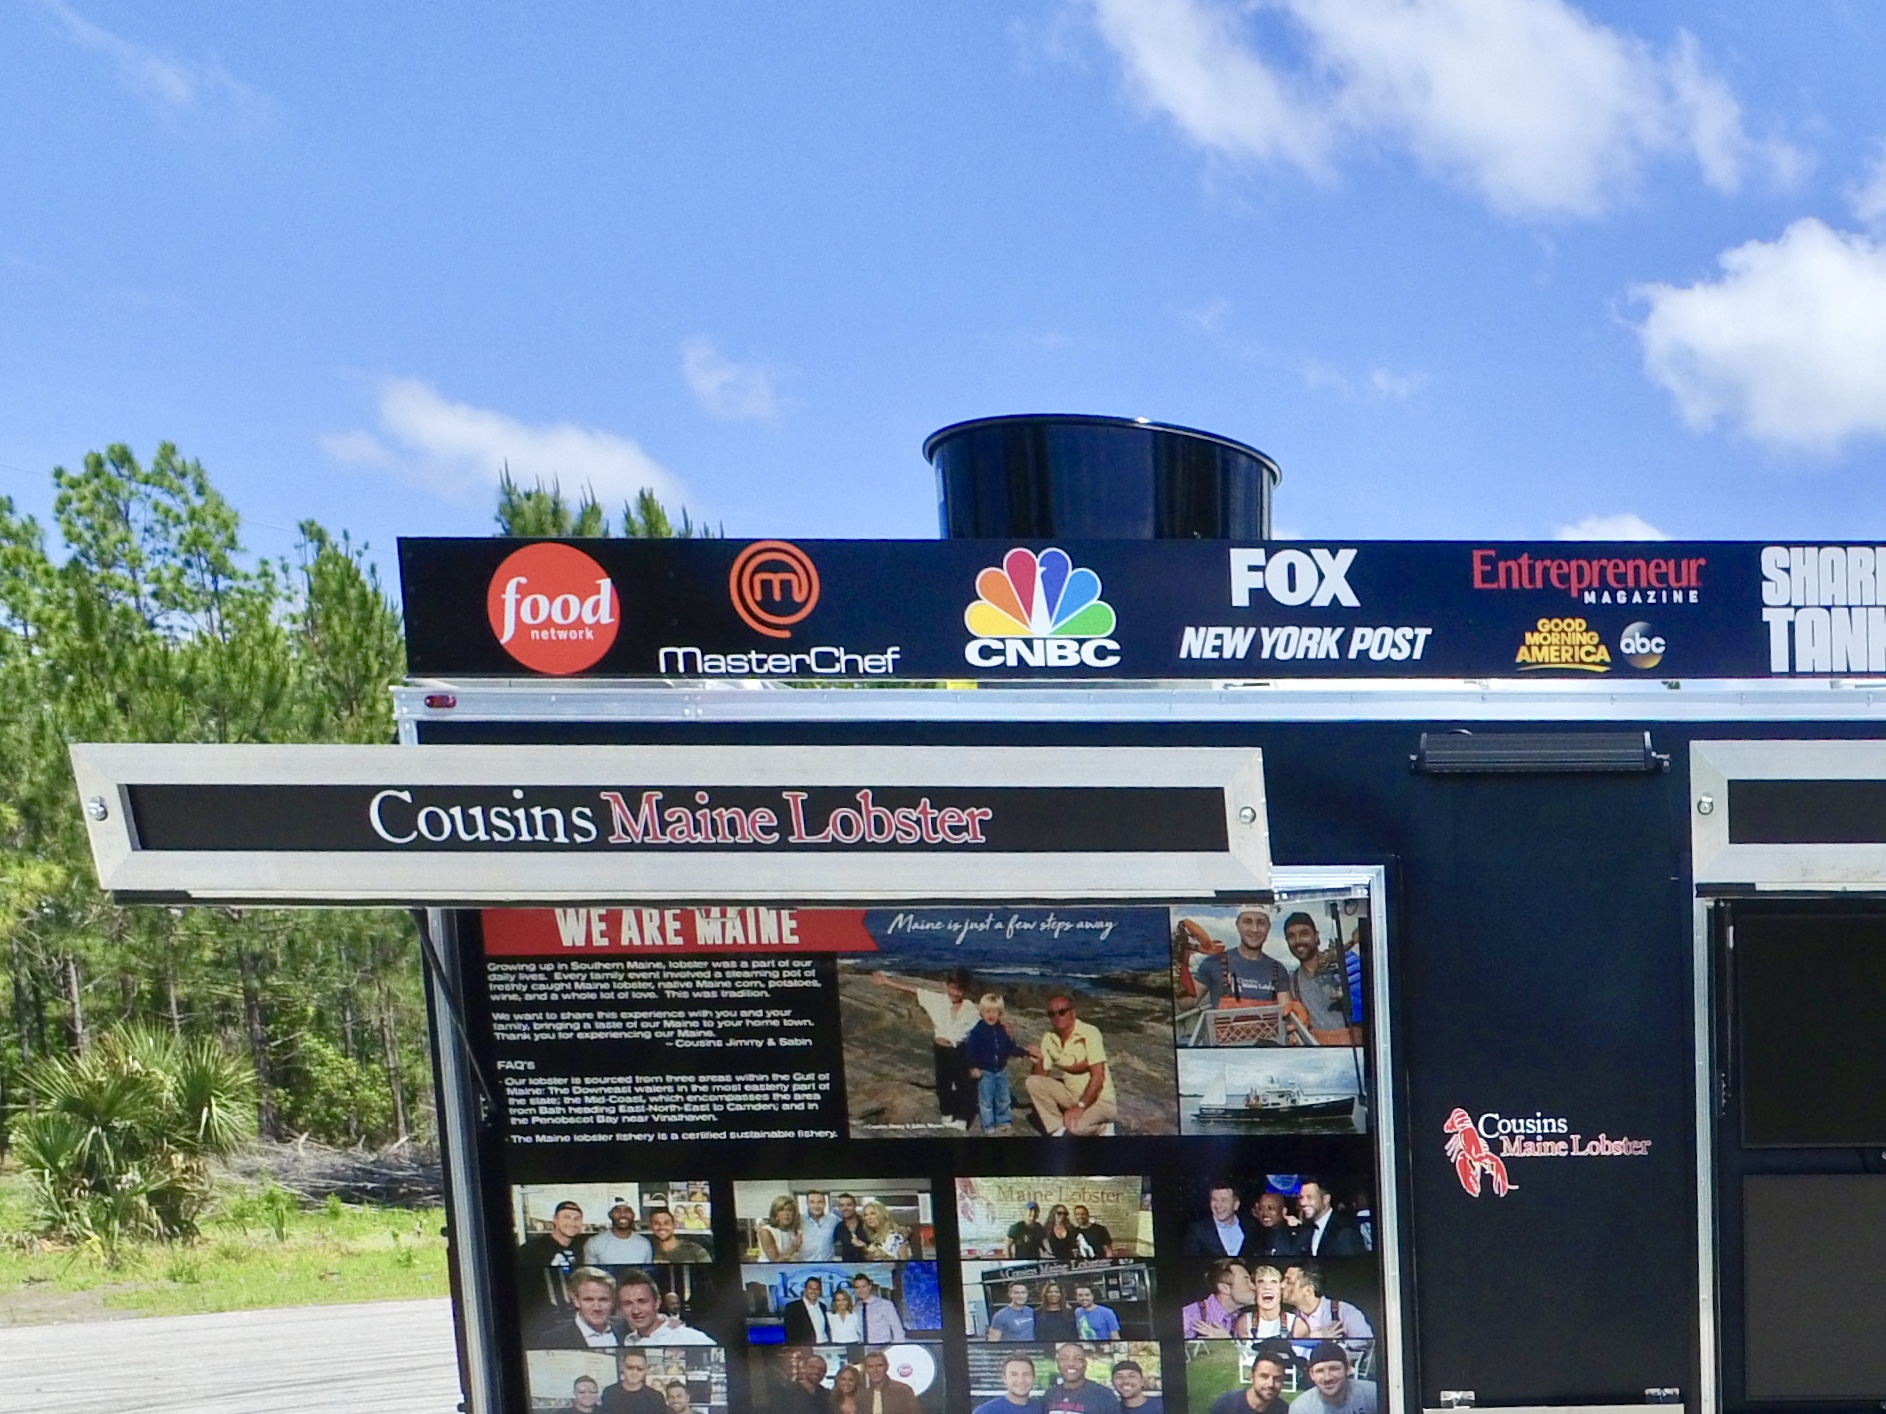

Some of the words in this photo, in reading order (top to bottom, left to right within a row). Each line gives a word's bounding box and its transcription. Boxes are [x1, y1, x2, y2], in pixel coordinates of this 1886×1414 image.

[1229, 547, 1361, 607] FOX
[1472, 549, 1707, 597] Entrepreneur
[500, 575, 615, 643] food
[1583, 590, 1700, 604] MAGAZINE
[529, 626, 595, 641] network
[1525, 632, 1600, 646] MORNING
[1537, 618, 1587, 632] GOOD
[964, 639, 1121, 667] CNBC
[1179, 626, 1256, 660] NEW
[1257, 626, 1344, 660] YORK
[1347, 627, 1432, 660] POST
[1515, 645, 1612, 663] AMERICA
[1619, 631, 1666, 654] abc
[658, 645, 901, 675] MasterChef
[368, 789, 598, 844] Cousins
[599, 789, 780, 845] Maine
[780, 788, 993, 844] Lobster
[554, 908, 610, 946] WE
[620, 908, 684, 946] ARE
[694, 907, 800, 945] MAINE
[887, 912, 945, 934] Maine
[947, 917, 963, 931] is
[955, 912, 994, 945] just
[1006, 913, 1038, 939] few
[1039, 912, 1074, 939] steps
[1076, 919, 1118, 941] away
[1478, 1112, 1569, 1139] Cousins
[1499, 1134, 1569, 1157] Maine
[1569, 1133, 1653, 1156] Lobster
